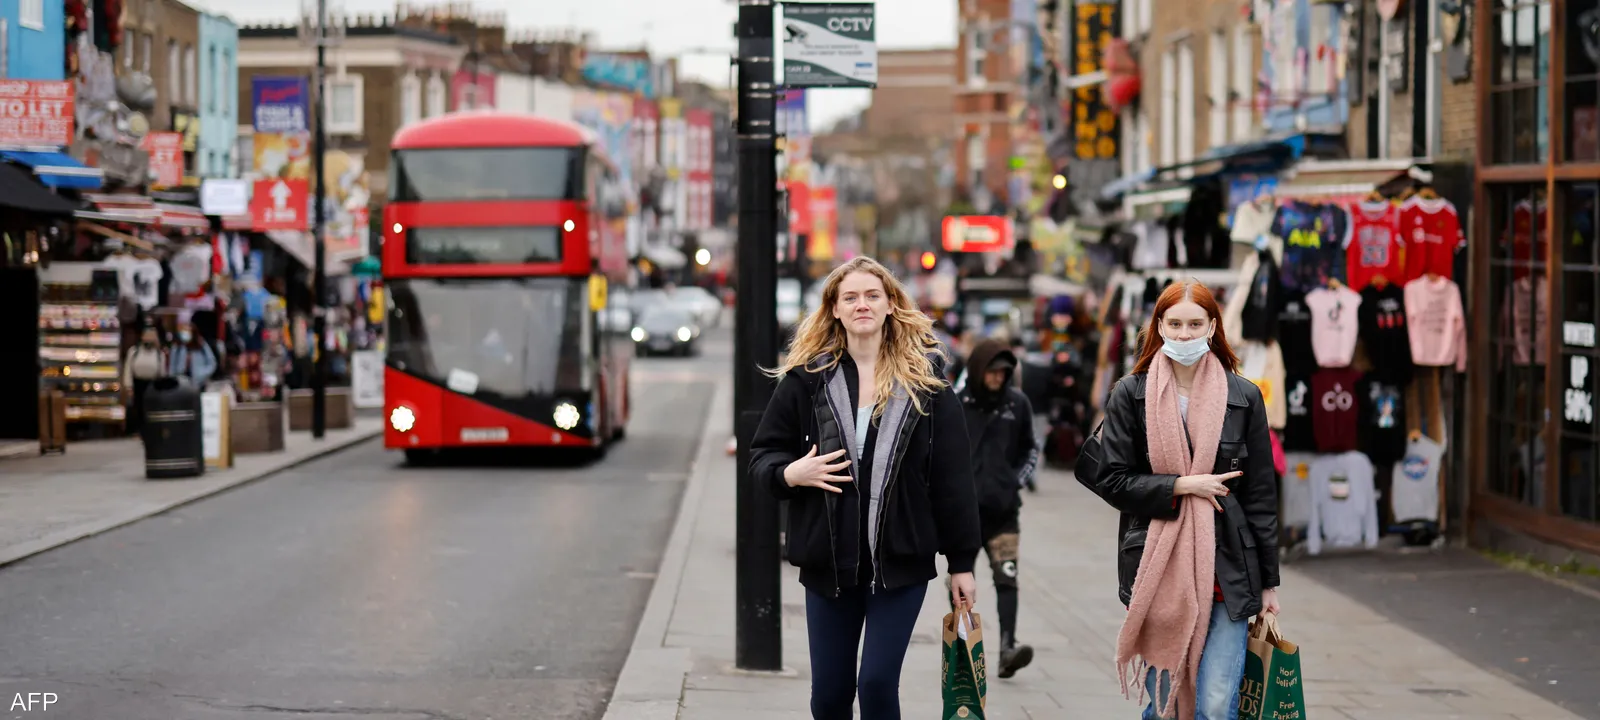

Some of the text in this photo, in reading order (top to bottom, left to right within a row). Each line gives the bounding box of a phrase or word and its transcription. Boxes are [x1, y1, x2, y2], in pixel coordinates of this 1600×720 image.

[827, 17, 873, 32] CCTV
[0, 81, 28, 97] HOP
[28, 100, 65, 118] LET
[1571, 355, 1588, 388] UP
[1239, 676, 1262, 699] OLE
